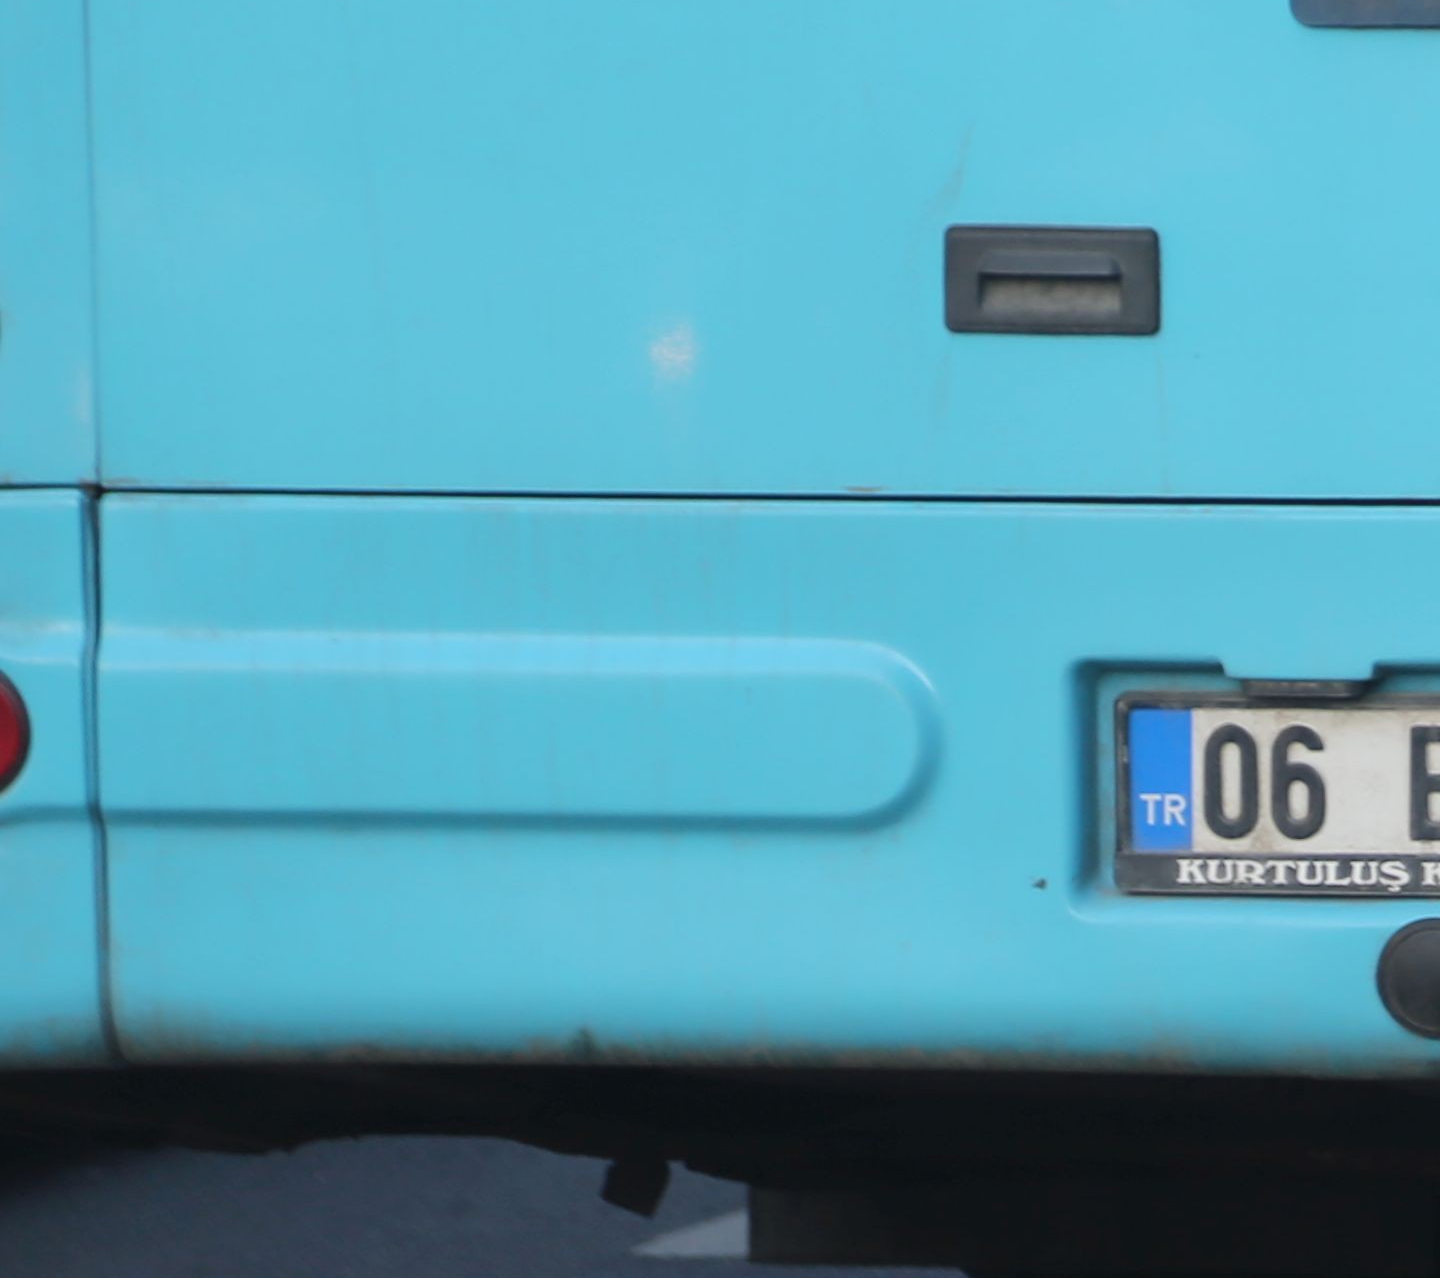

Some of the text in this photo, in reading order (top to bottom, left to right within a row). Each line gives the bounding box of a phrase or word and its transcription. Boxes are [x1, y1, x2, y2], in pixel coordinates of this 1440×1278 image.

[1203, 723, 1326, 841] 06
[1140, 793, 1187, 827] TR
[1177, 859, 1409, 895] KURTULUŞ
